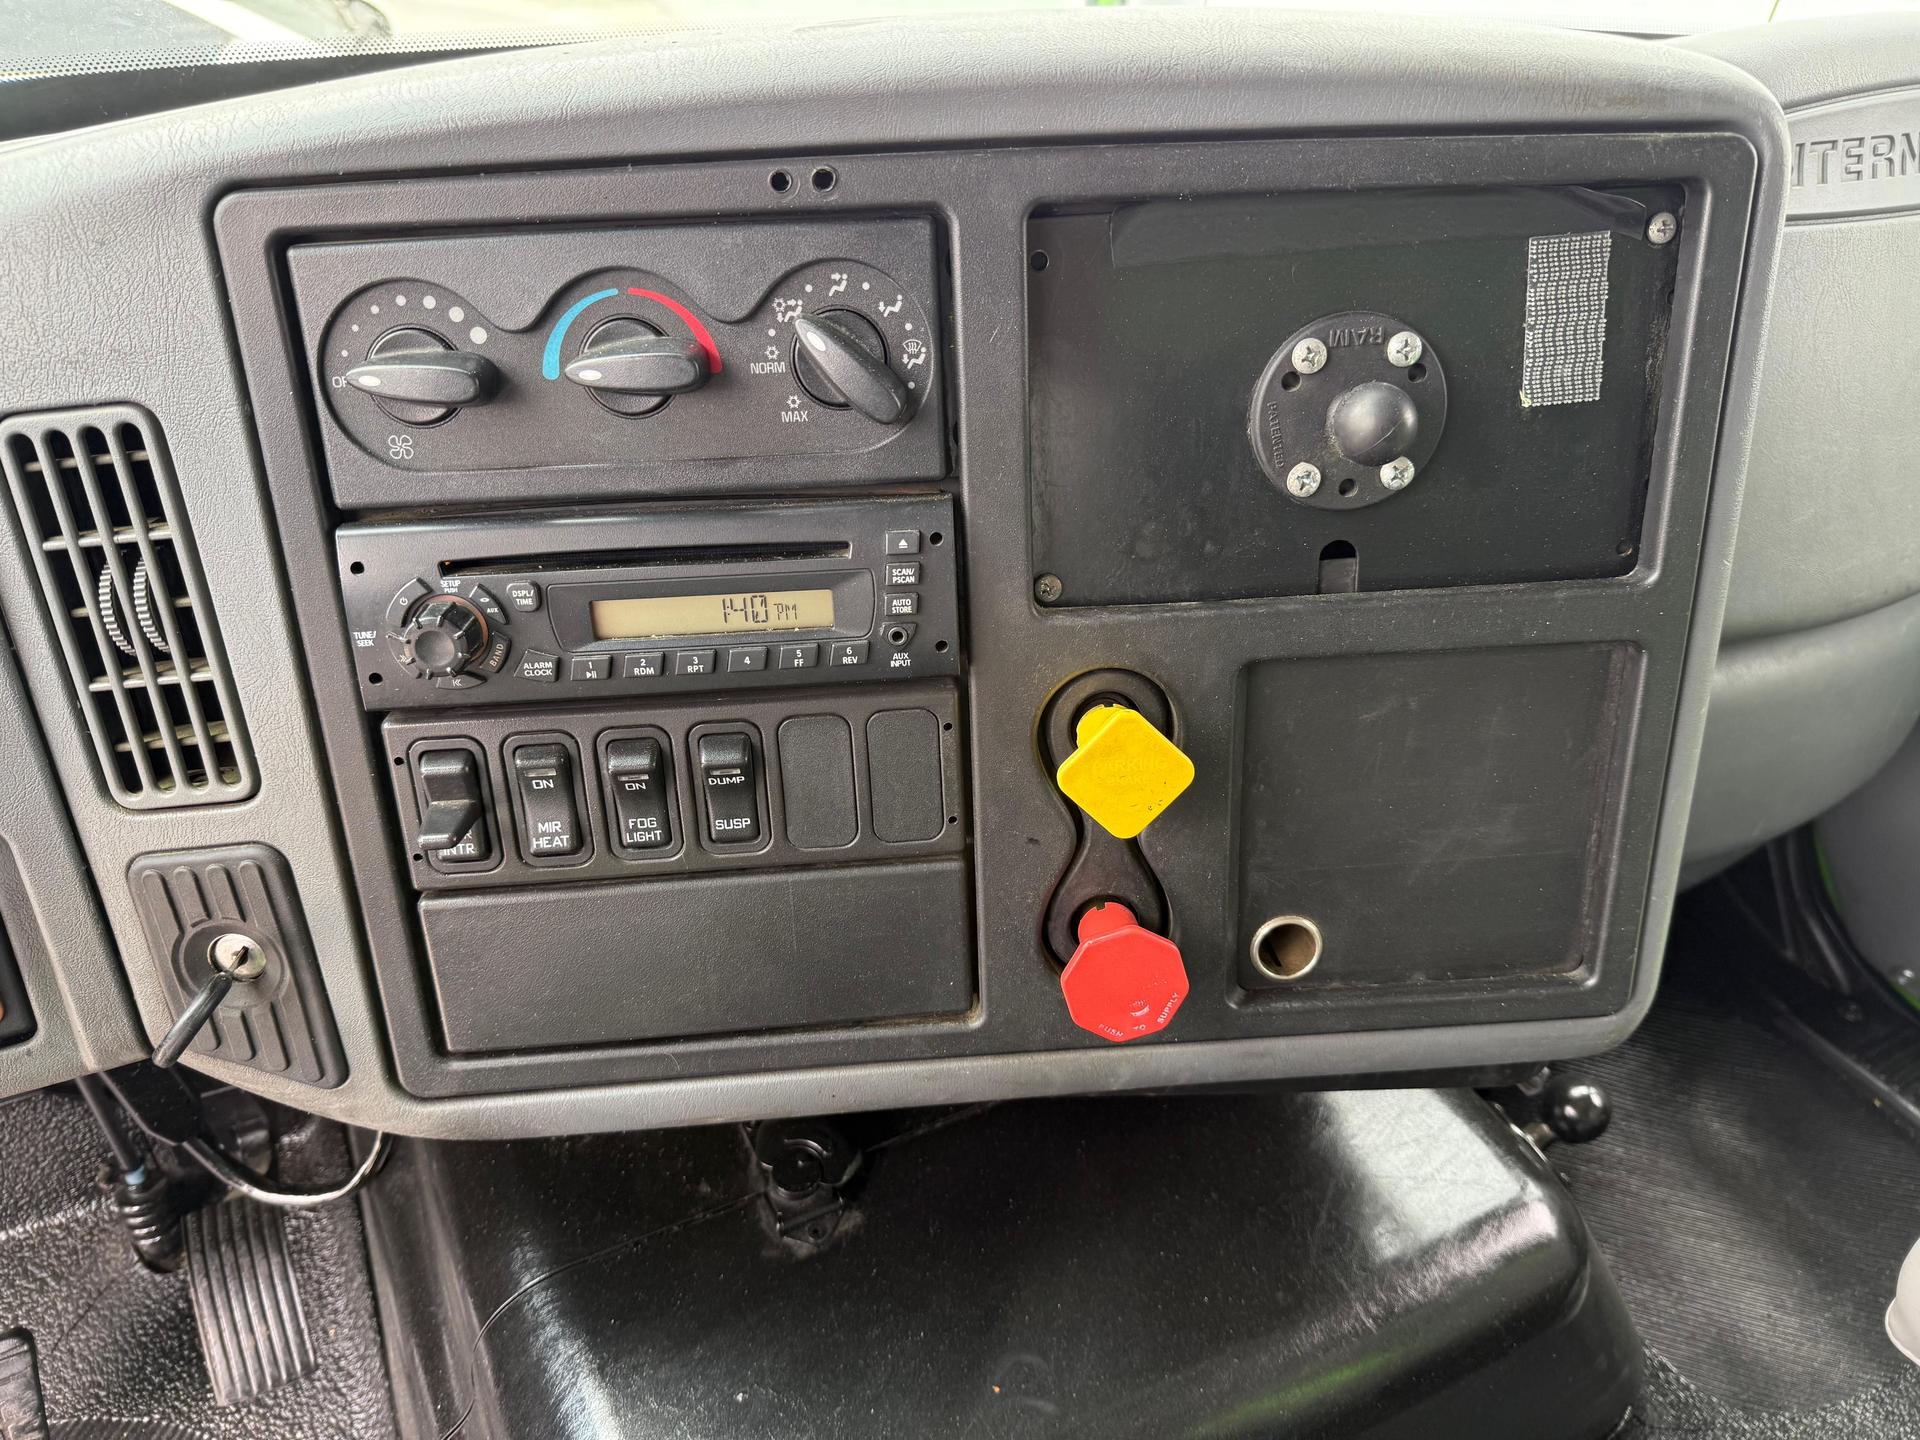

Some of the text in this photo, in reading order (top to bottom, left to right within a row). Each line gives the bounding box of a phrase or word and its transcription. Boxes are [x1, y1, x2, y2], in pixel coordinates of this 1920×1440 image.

[1328, 326, 1386, 348] RAM
[750, 361, 786, 374] NORM
[781, 410, 809, 423] MAX
[1266, 400, 1285, 468] PATENTED
[892, 567, 915, 576] SCAN/
[892, 575, 915, 584] PSCAN
[512, 589, 534, 598] DSPL/
[516, 597, 534, 606] TIME
[892, 598, 912, 607] AUTO
[722, 594, 798, 624] 1:40 PM
[891, 605, 913, 614] STORE
[352, 630, 377, 640] TUNE/
[356, 639, 375, 647] SEEK
[489, 642, 504, 668] BAND
[796, 649, 802, 658] 5
[846, 646, 852, 655] 6
[692, 656, 699, 665] 3
[743, 656, 751, 665] 4
[842, 655, 858, 665] REV
[892, 652, 909, 661] AUX
[523, 660, 553, 670] ALARM
[640, 658, 646, 667] 2
[794, 659, 804, 667] FF
[890, 659, 911, 668] INPUT
[524, 668, 553, 677] CLOCK
[633, 666, 655, 676] RDM
[687, 664, 704, 673] RPT
[532, 778, 554, 790] ON
[708, 775, 745, 786] DUMP
[625, 782, 647, 791] ON
[538, 820, 562, 834] MIR
[628, 817, 657, 830] FOG
[715, 818, 752, 831] SUSP
[626, 830, 663, 843] LIGHT
[532, 835, 570, 849] HEAT
[1156, 991, 1180, 1025] SUPPLY
